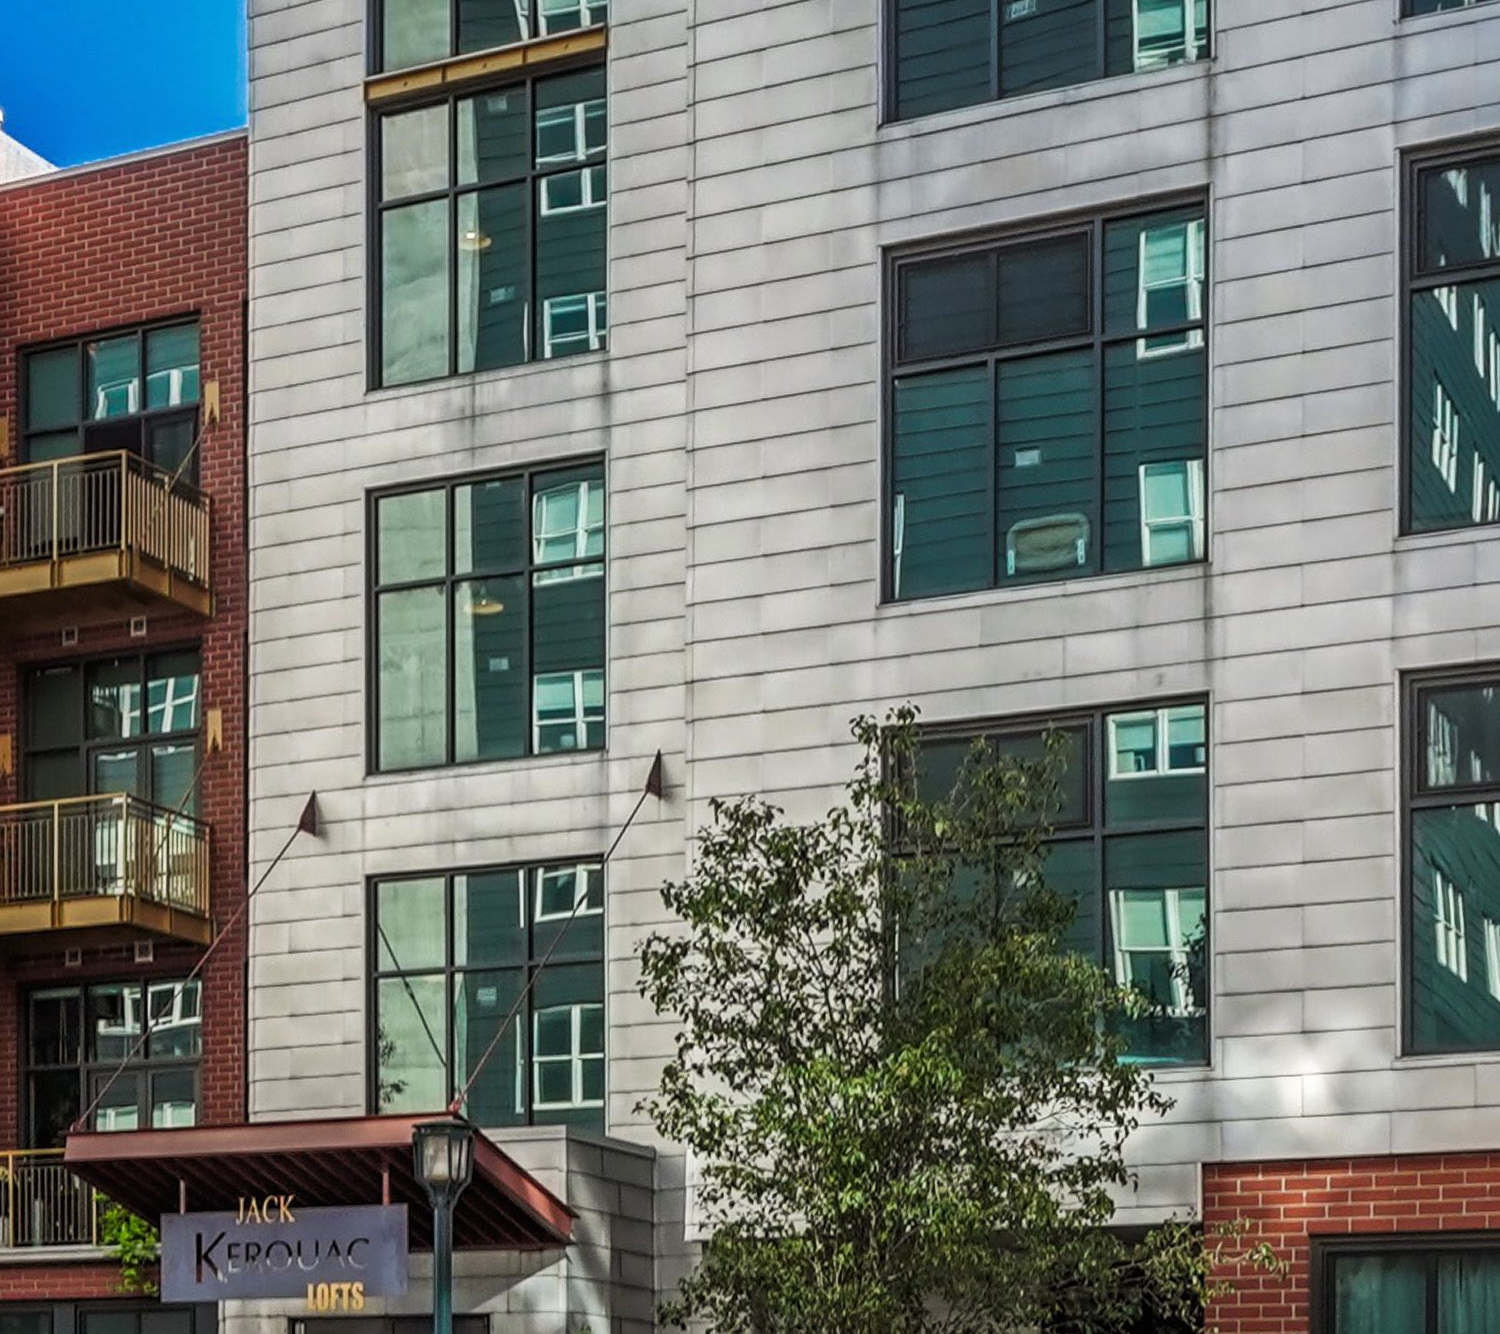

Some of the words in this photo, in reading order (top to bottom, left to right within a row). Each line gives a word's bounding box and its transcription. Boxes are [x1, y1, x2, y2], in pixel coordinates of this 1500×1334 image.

[235, 1194, 297, 1226] JACK
[195, 1230, 371, 1284] KEROUAC
[306, 1281, 366, 1312] LOFTS
